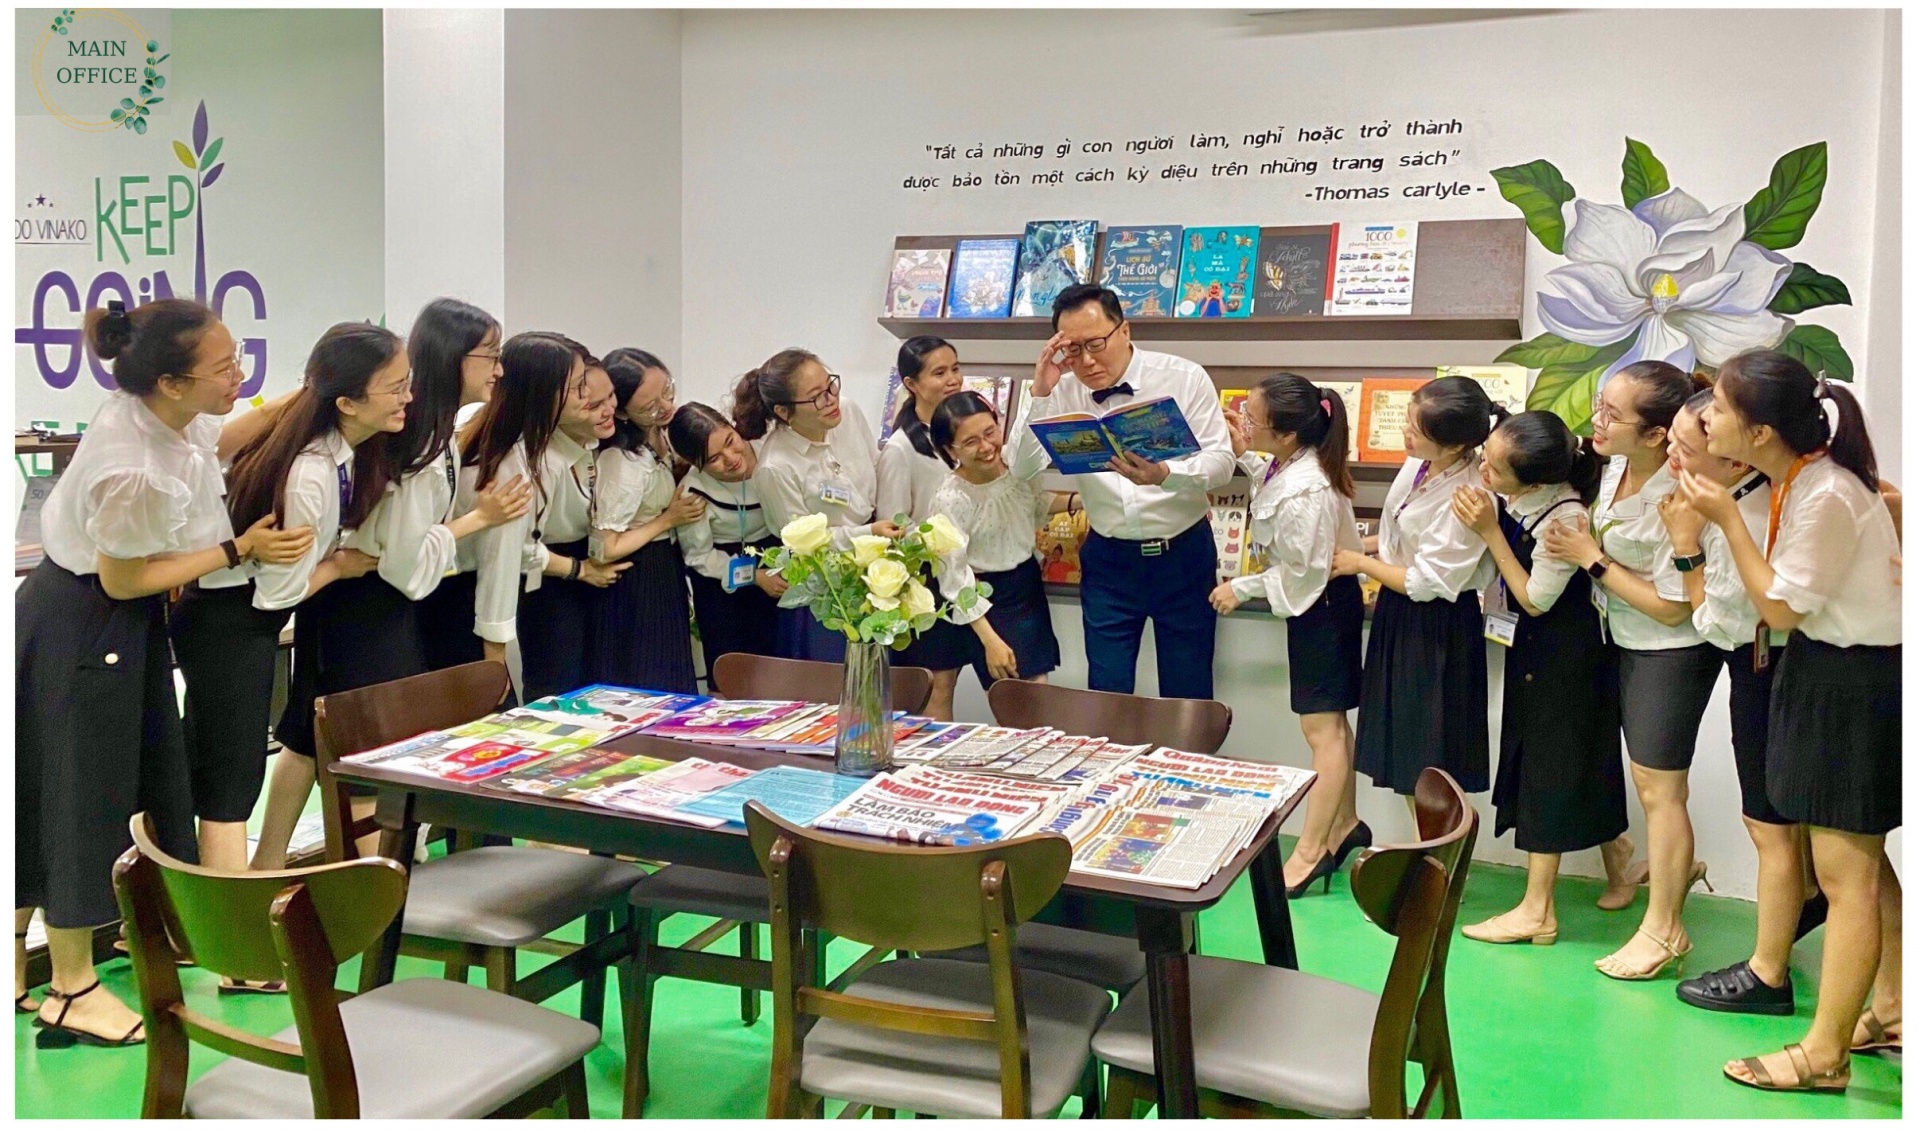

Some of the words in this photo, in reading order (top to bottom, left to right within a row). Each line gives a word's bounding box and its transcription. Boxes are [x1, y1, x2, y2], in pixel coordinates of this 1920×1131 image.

[965, 142, 983, 159] cả
[993, 141, 1044, 159] những
[1056, 138, 1071, 158] gì
[1082, 141, 1113, 153] con
[1190, 132, 1229, 149] làm,
[1243, 125, 1285, 148] nghĩ
[1298, 125, 1345, 145] hoặc
[1360, 119, 1391, 138] trở
[1405, 119, 1462, 136] thành
[903, 175, 940, 192] được
[952, 172, 982, 187] bảo
[994, 169, 1020, 186] tồn
[1031, 170, 1064, 185] một
[1075, 167, 1114, 183] cách
[1161, 164, 1197, 180] diệu
[1211, 161, 1248, 176] trên
[1260, 156, 1318, 175] những
[1332, 156, 1384, 172] trang
[1402, 181, 1471, 200] carlyle
[36, 219, 87, 241] VINAKO
[95, 174, 196, 265] KEEP
[1366, 231, 1392, 242] 1000
[15, 270, 267, 399] GOG
